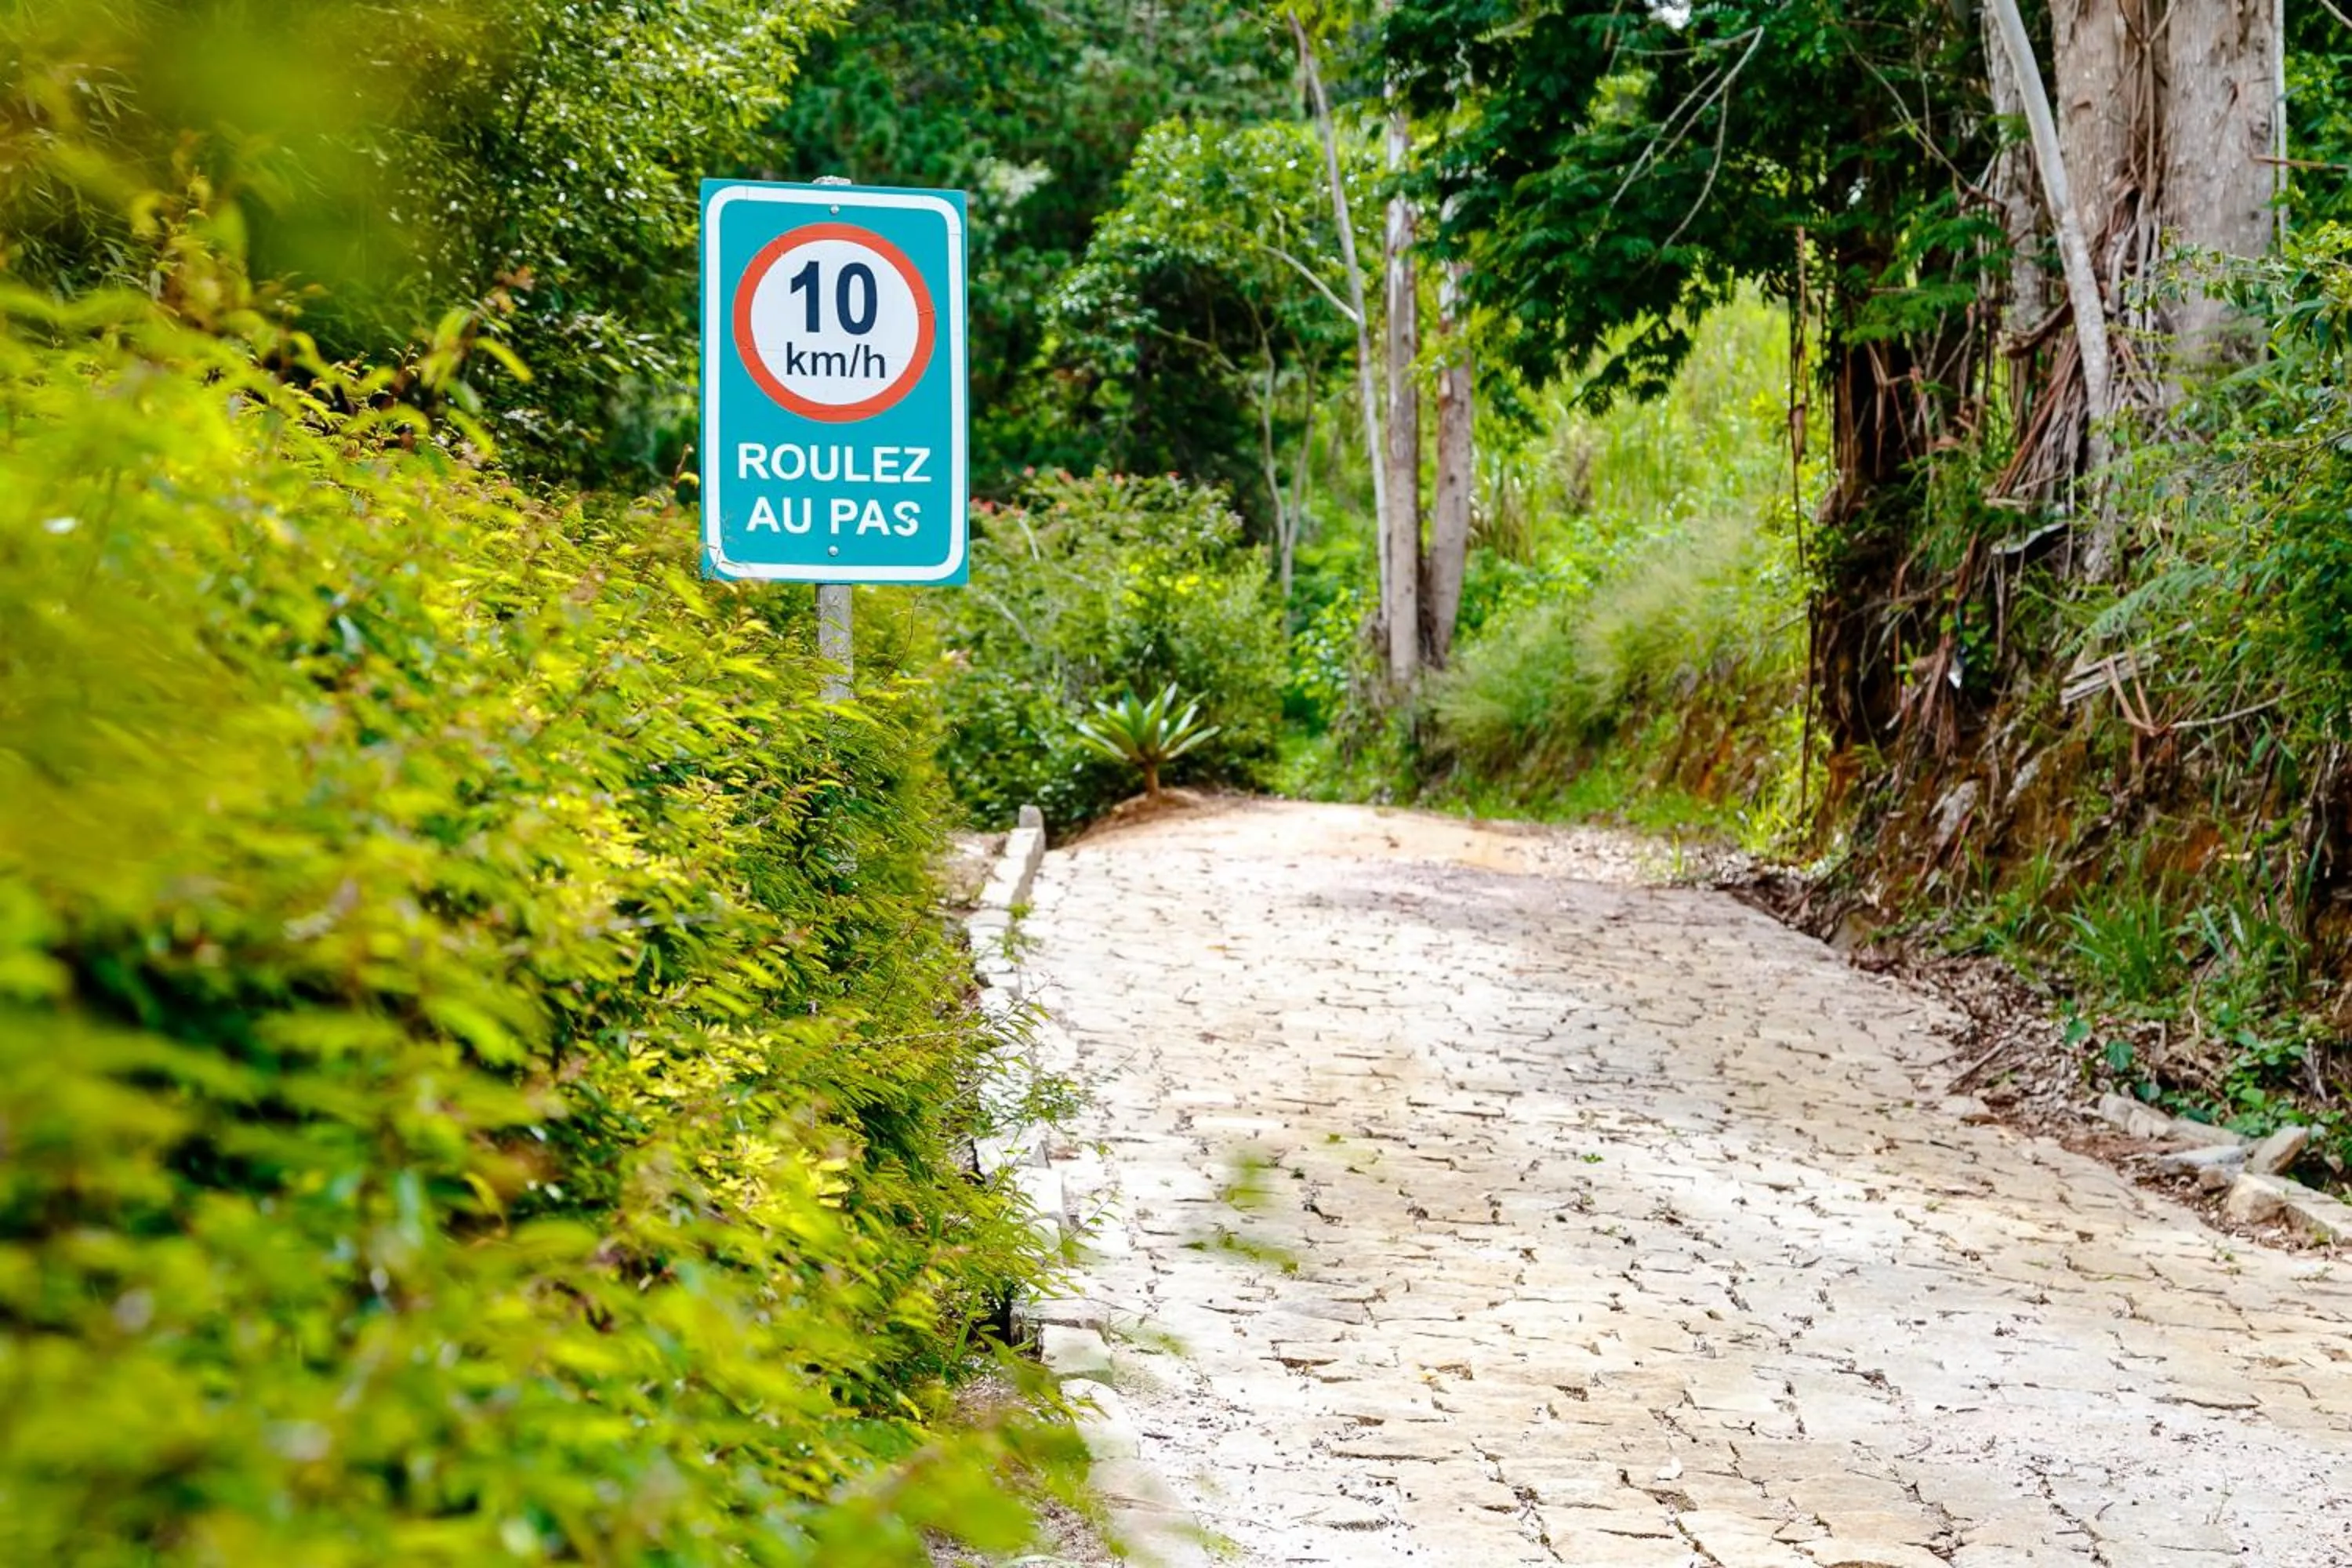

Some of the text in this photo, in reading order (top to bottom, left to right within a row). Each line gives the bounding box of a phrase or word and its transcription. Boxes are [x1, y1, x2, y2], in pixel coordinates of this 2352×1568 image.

[790, 260, 878, 336] 10
[786, 341, 886, 378] km/h
[738, 443, 931, 483] ROULEZ
[746, 496, 921, 537] AU PAS
